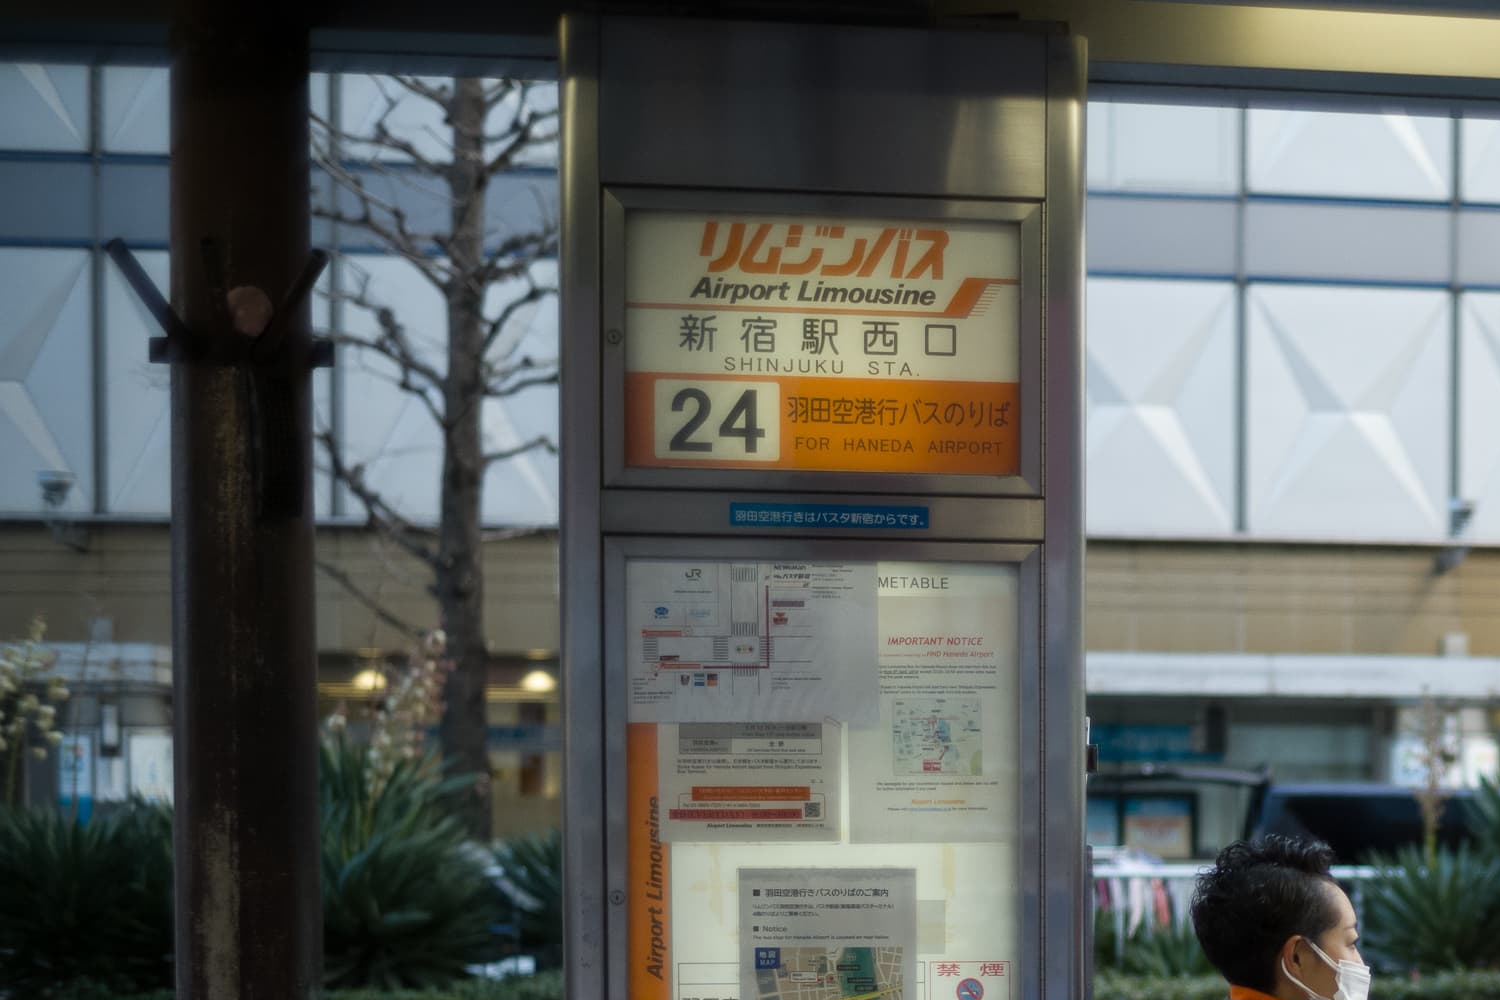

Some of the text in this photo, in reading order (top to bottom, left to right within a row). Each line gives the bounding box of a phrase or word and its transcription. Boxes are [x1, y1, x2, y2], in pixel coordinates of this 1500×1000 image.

[699, 221, 950, 280] リムジンバス
[690, 276, 937, 306] Airport Limousine
[679, 313, 957, 357] 新宿駅西口
[724, 356, 921, 377] SHINJUKU STA.
[669, 387, 766, 454] 24
[787, 396, 1010, 428] 羽田空港行バスのりば
[794, 437, 1002, 456] FOR HANEDA AIRPORT
[735, 510, 925, 526] 羽田空港行きはバスタ新宿からです。
[887, 636, 984, 646] IMPORTANT NOTICE
[763, 925, 788, 933] Notice
[646, 906, 667, 981] Airport
[936, 963, 1005, 977] 禁煙
